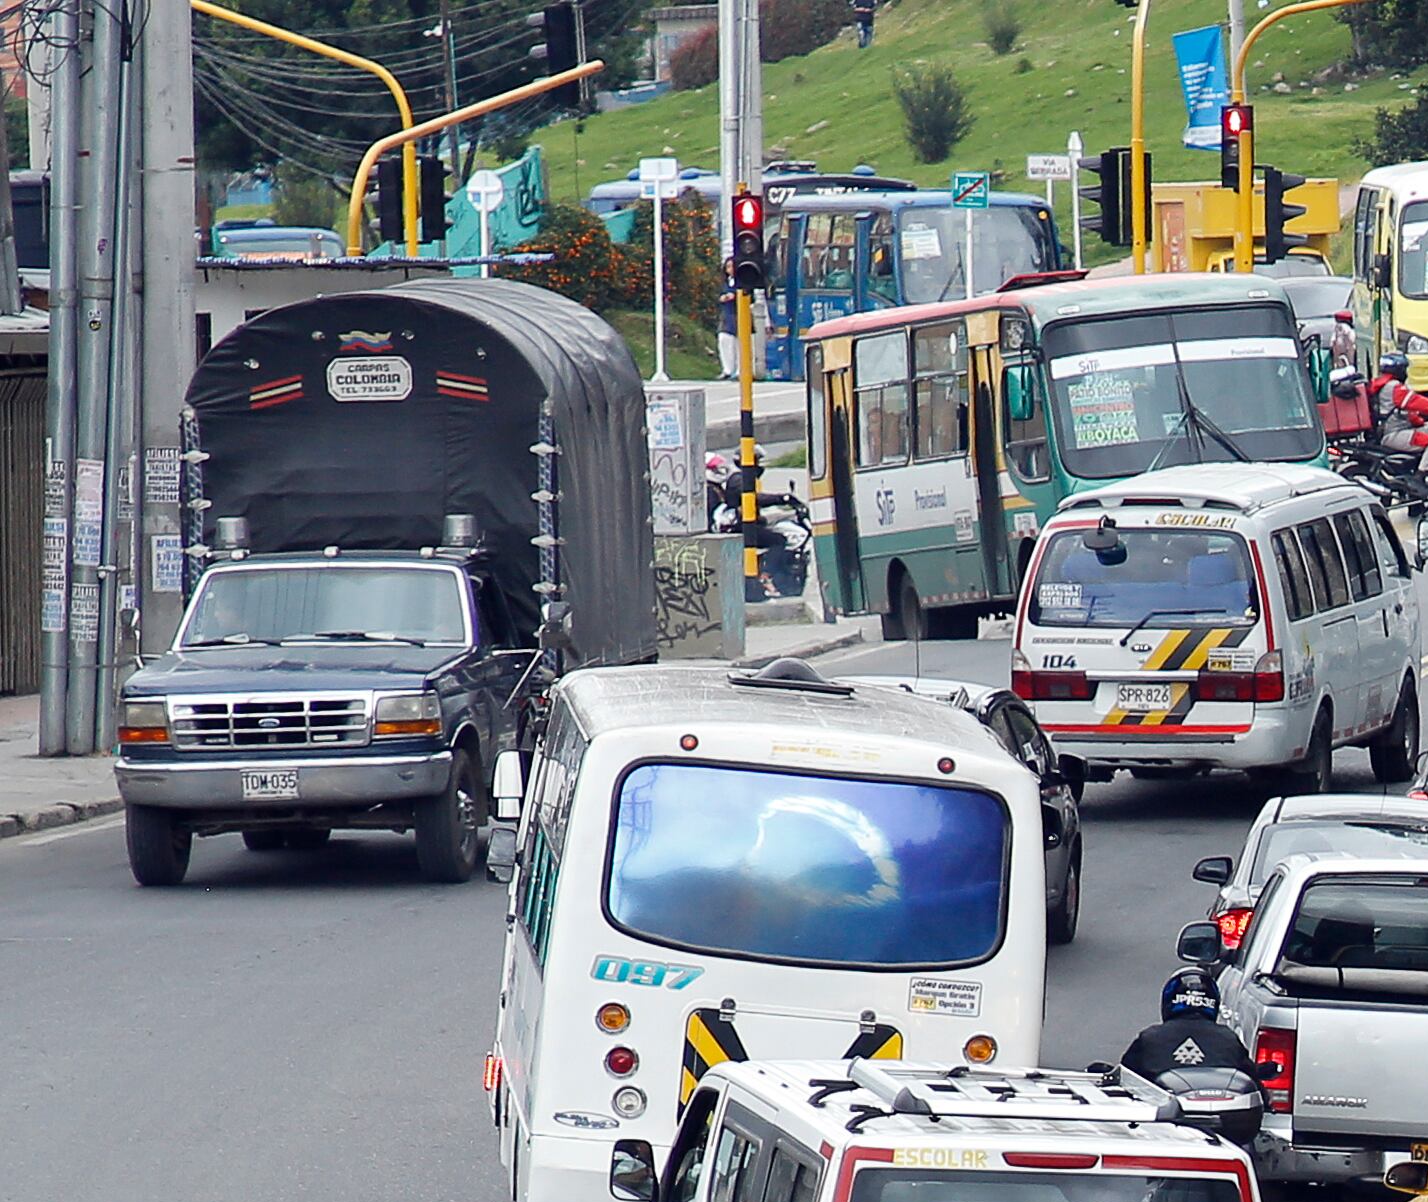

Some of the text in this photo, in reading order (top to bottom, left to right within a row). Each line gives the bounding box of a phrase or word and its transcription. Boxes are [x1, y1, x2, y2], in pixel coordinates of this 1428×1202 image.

[1043, 654, 1077, 669] 104
[590, 954, 705, 990] 097
[895, 1148, 988, 1168] ESCOLAR
